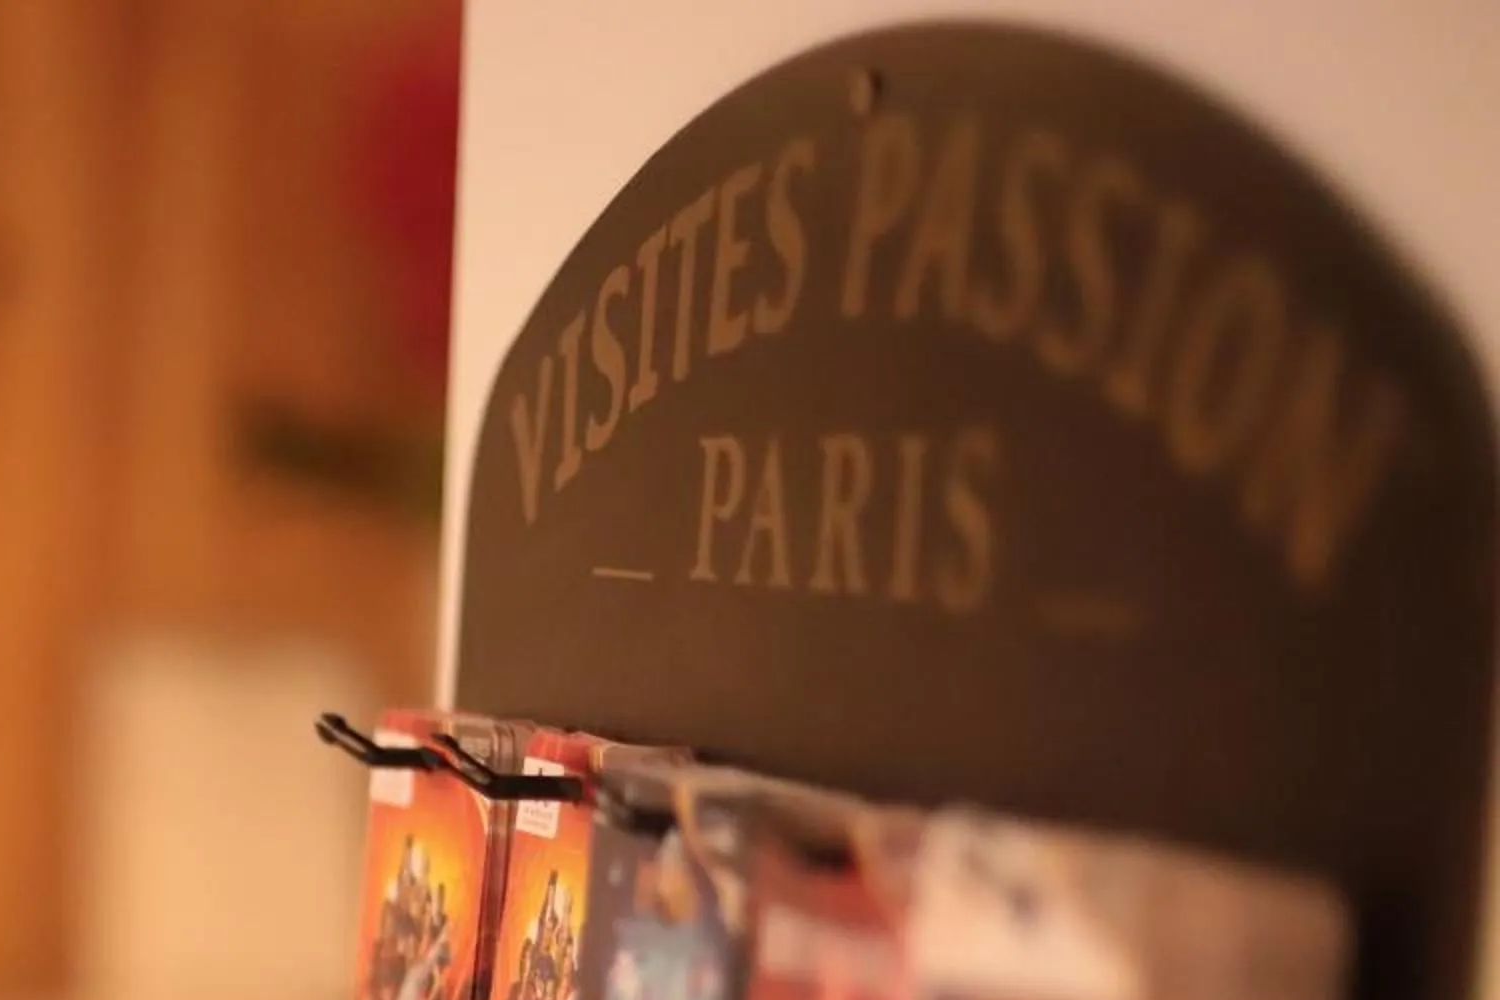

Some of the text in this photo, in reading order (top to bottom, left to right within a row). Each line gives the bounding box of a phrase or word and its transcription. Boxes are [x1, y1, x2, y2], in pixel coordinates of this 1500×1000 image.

[511, 110, 1408, 592] VISITES PASSION
[689, 430, 998, 613] PARIS
